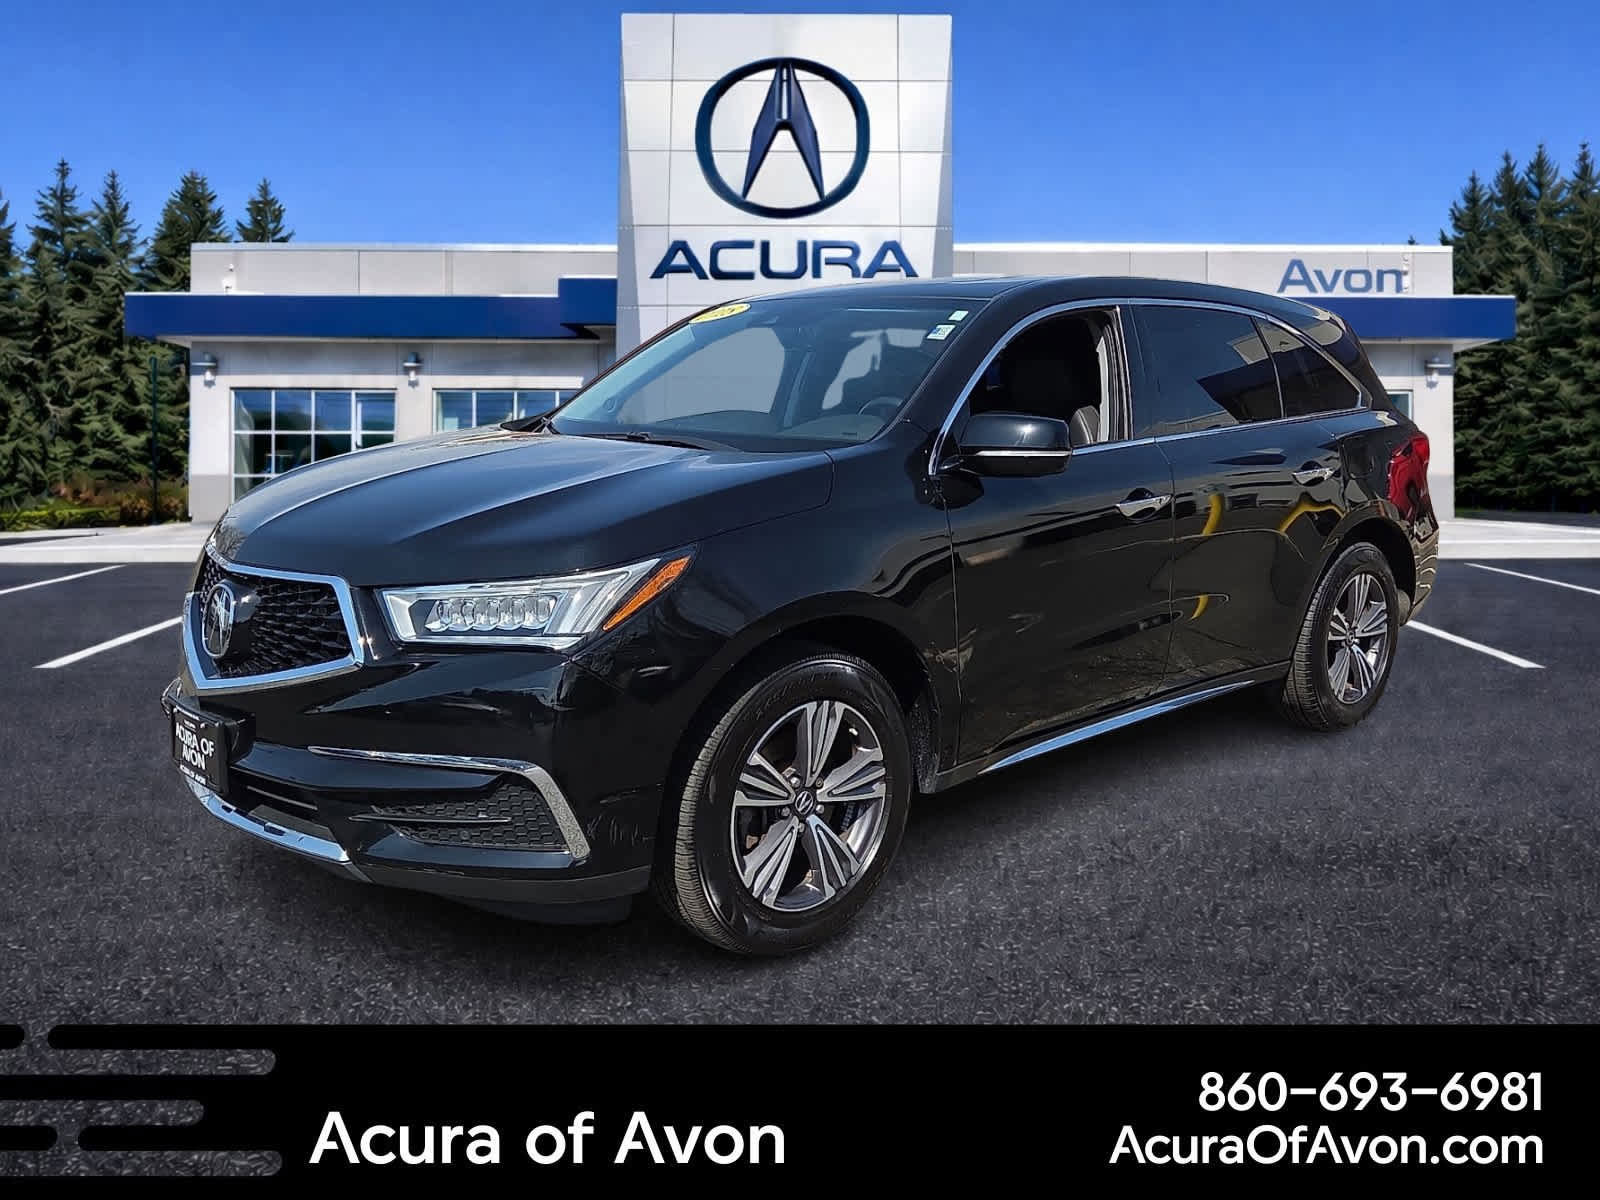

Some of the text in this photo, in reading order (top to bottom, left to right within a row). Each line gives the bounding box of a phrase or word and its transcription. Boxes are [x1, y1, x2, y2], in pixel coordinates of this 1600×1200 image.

[650, 239, 919, 280] ACURA
[1277, 258, 1404, 294] Avon
[200, 738, 214, 757] OF
